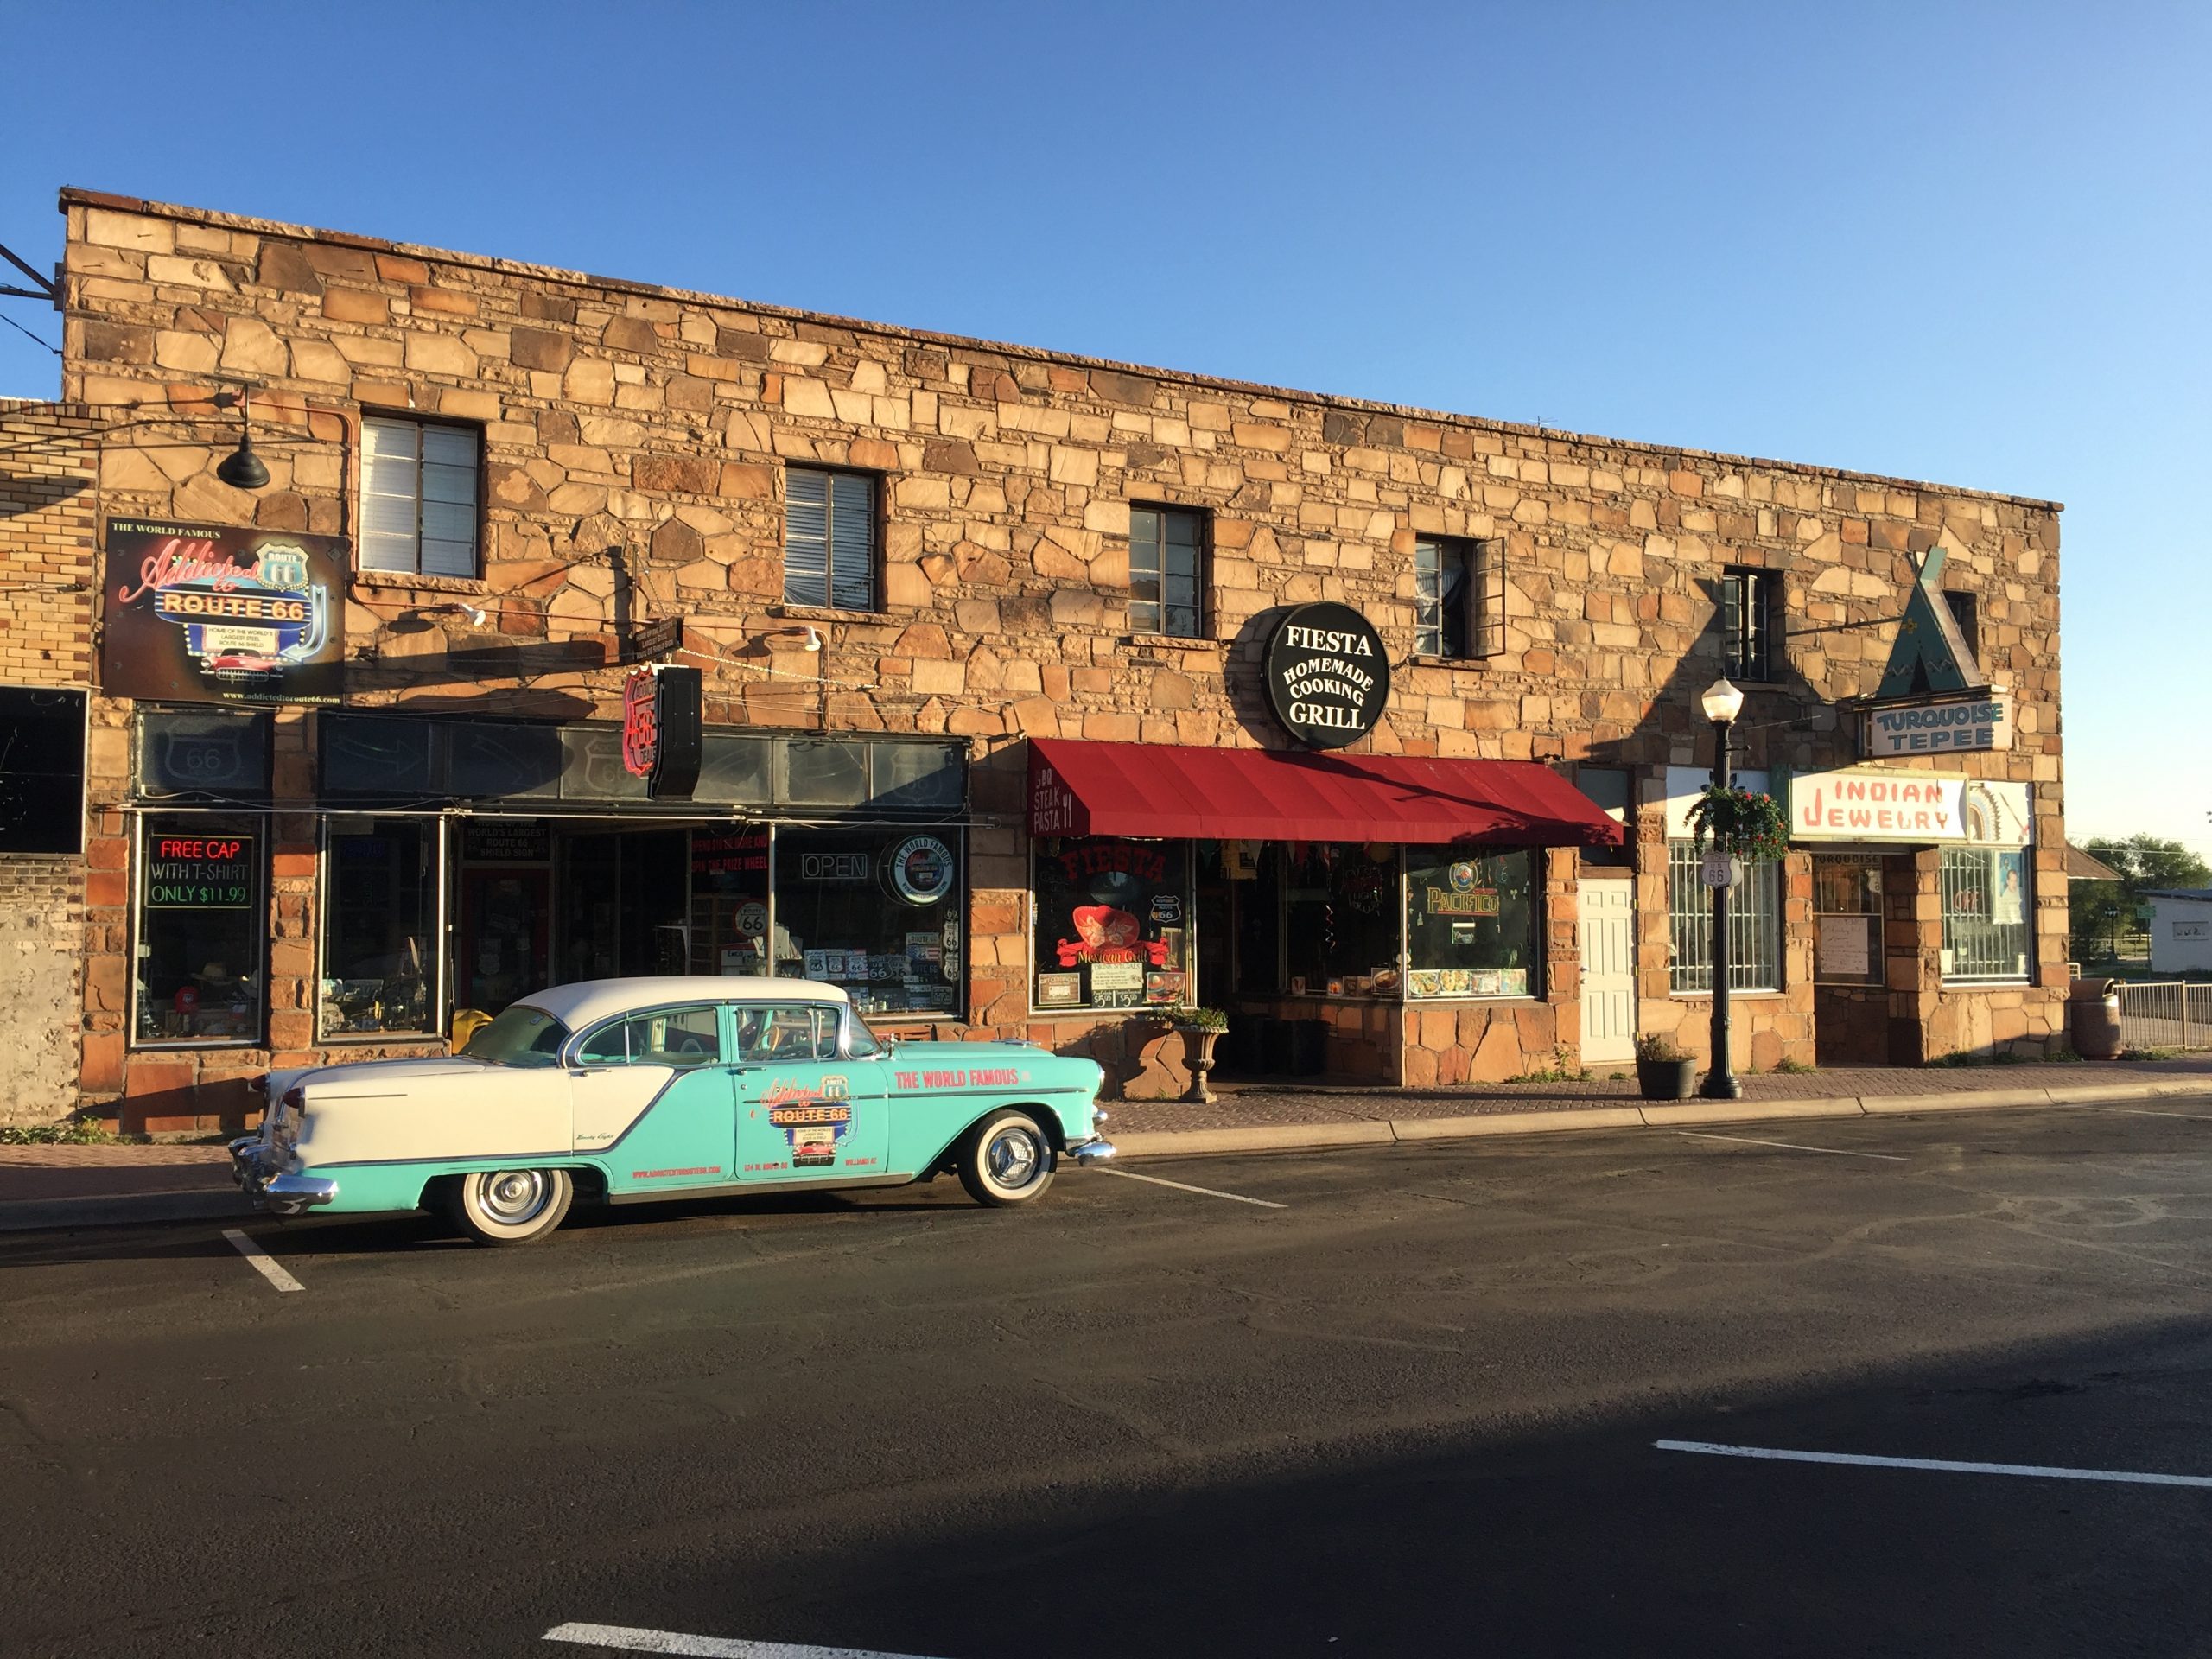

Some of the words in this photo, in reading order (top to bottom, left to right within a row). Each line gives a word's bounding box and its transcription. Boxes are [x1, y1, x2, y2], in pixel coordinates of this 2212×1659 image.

[111, 522, 134, 532] THE
[137, 524, 175, 535] WORLD
[178, 528, 221, 539] FAMOUS
[268, 552, 297, 562] ROUTE
[118, 538, 260, 603] Addicted
[270, 564, 296, 584] 66
[162, 593, 263, 619] ROUTE
[270, 601, 304, 621] 66
[1285, 625, 1374, 657] FIESTA
[1282, 658, 1374, 692] HOMEMADE
[222, 692, 340, 704] www.addictedtoroute66.com
[1289, 678, 1364, 707] COOKING
[1289, 702, 1365, 730] GRILL
[1876, 702, 2004, 732] TURQUOISE
[1888, 728, 1994, 750] TEPEE
[1034, 786, 1060, 810] STEAK
[1834, 780, 1942, 803] INDIAN
[1803, 787, 1949, 830] JEWELRY
[1034, 809, 1060, 835] PASTA
[486, 837, 517, 847] ROUTE
[509, 829, 547, 837] LARGEST
[161, 840, 203, 858] FREE
[207, 841, 241, 859] CAP
[896, 852, 906, 868] THE
[904, 838, 928, 855] WORLD
[930, 840, 953, 868] FAMOUS
[744, 855, 768, 871] WHEEL
[805, 855, 865, 877] OPEN
[1058, 844, 1166, 882] FIESTA
[1814, 854, 1881, 865] TURQUOISE
[150, 862, 189, 880] WITH
[193, 863, 248, 880] T-SHIRT
[1708, 869, 1724, 883] 66
[151, 885, 196, 902] ONLY
[1427, 887, 1500, 913] PACIFICO
[743, 916, 764, 931] 66
[1160, 911, 1173, 919] 66
[946, 936, 957, 947] 66
[1077, 950, 1122, 964] Mexican
[1125, 949, 1148, 963] Grill
[869, 968, 887, 978] 66
[947, 967, 957, 978] 66
[894, 1071, 920, 1090] THE
[922, 1070, 966, 1089] WORLD
[969, 1068, 1019, 1087] FAMOUS
[772, 1109, 826, 1122] ROUTE
[830, 1109, 849, 1121] 66
